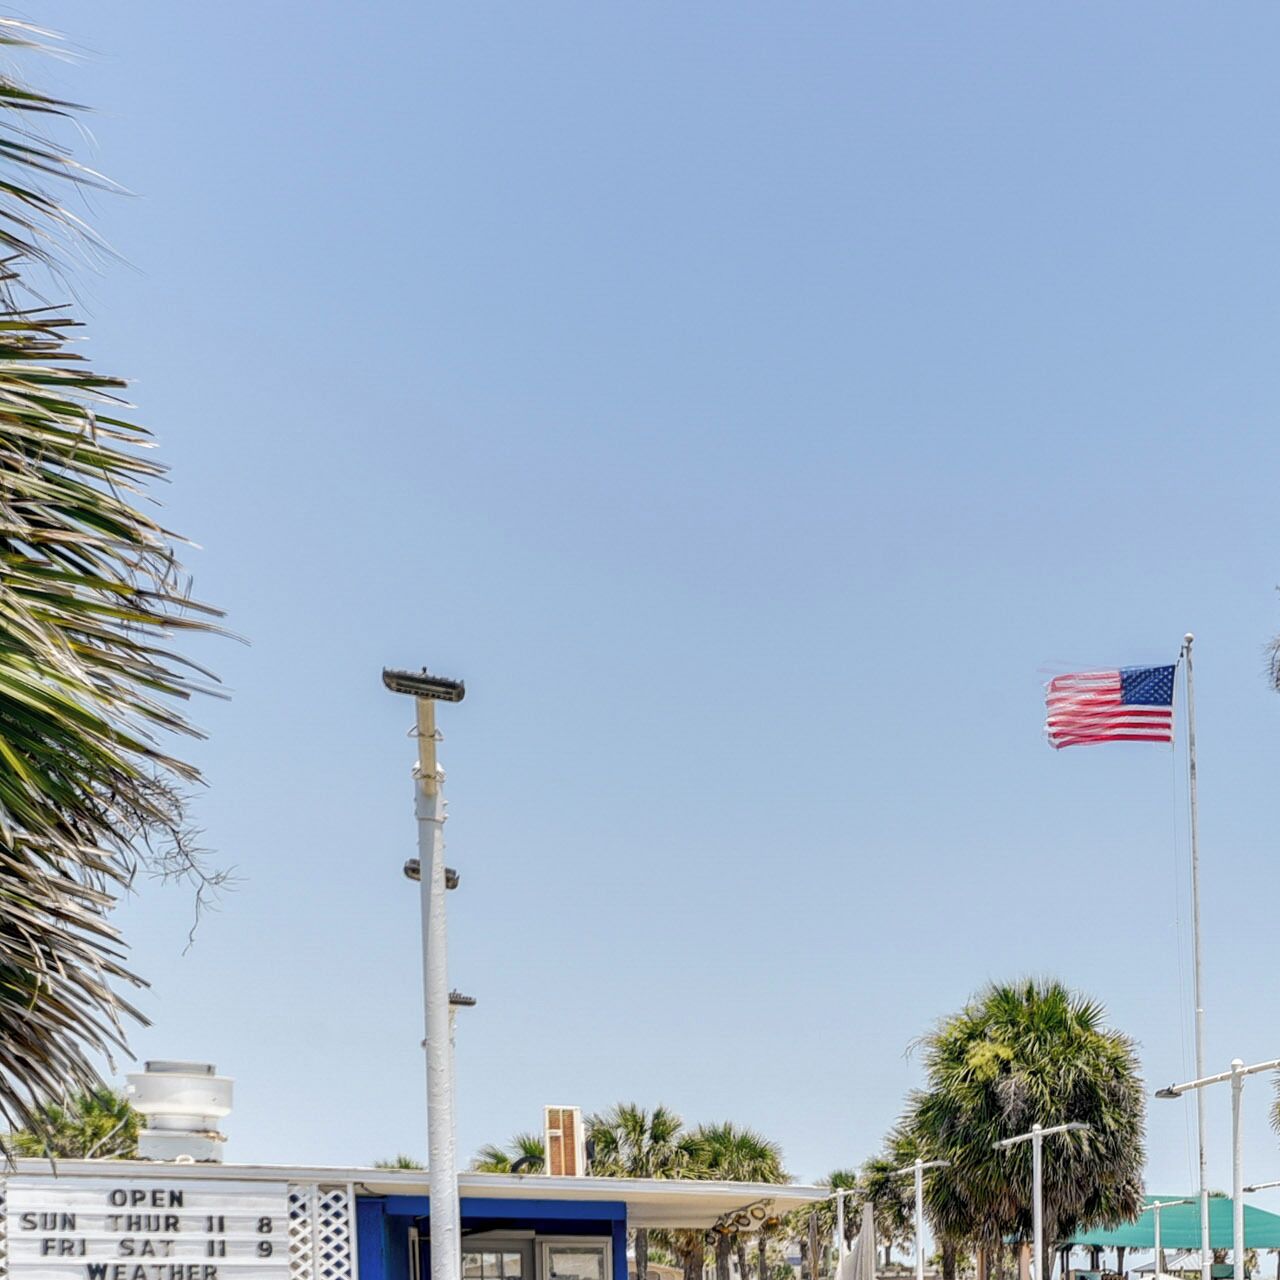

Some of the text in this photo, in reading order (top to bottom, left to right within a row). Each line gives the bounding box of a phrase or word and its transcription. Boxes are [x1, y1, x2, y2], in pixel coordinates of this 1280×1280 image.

[110, 1189, 184, 1208] OPEN
[20, 1212, 77, 1231] SUN
[107, 1214, 180, 1233] THUR
[257, 1216, 273, 1234] 8
[41, 1238, 87, 1257] FRI
[118, 1239, 176, 1257] SAT
[257, 1240, 273, 1258] 9
